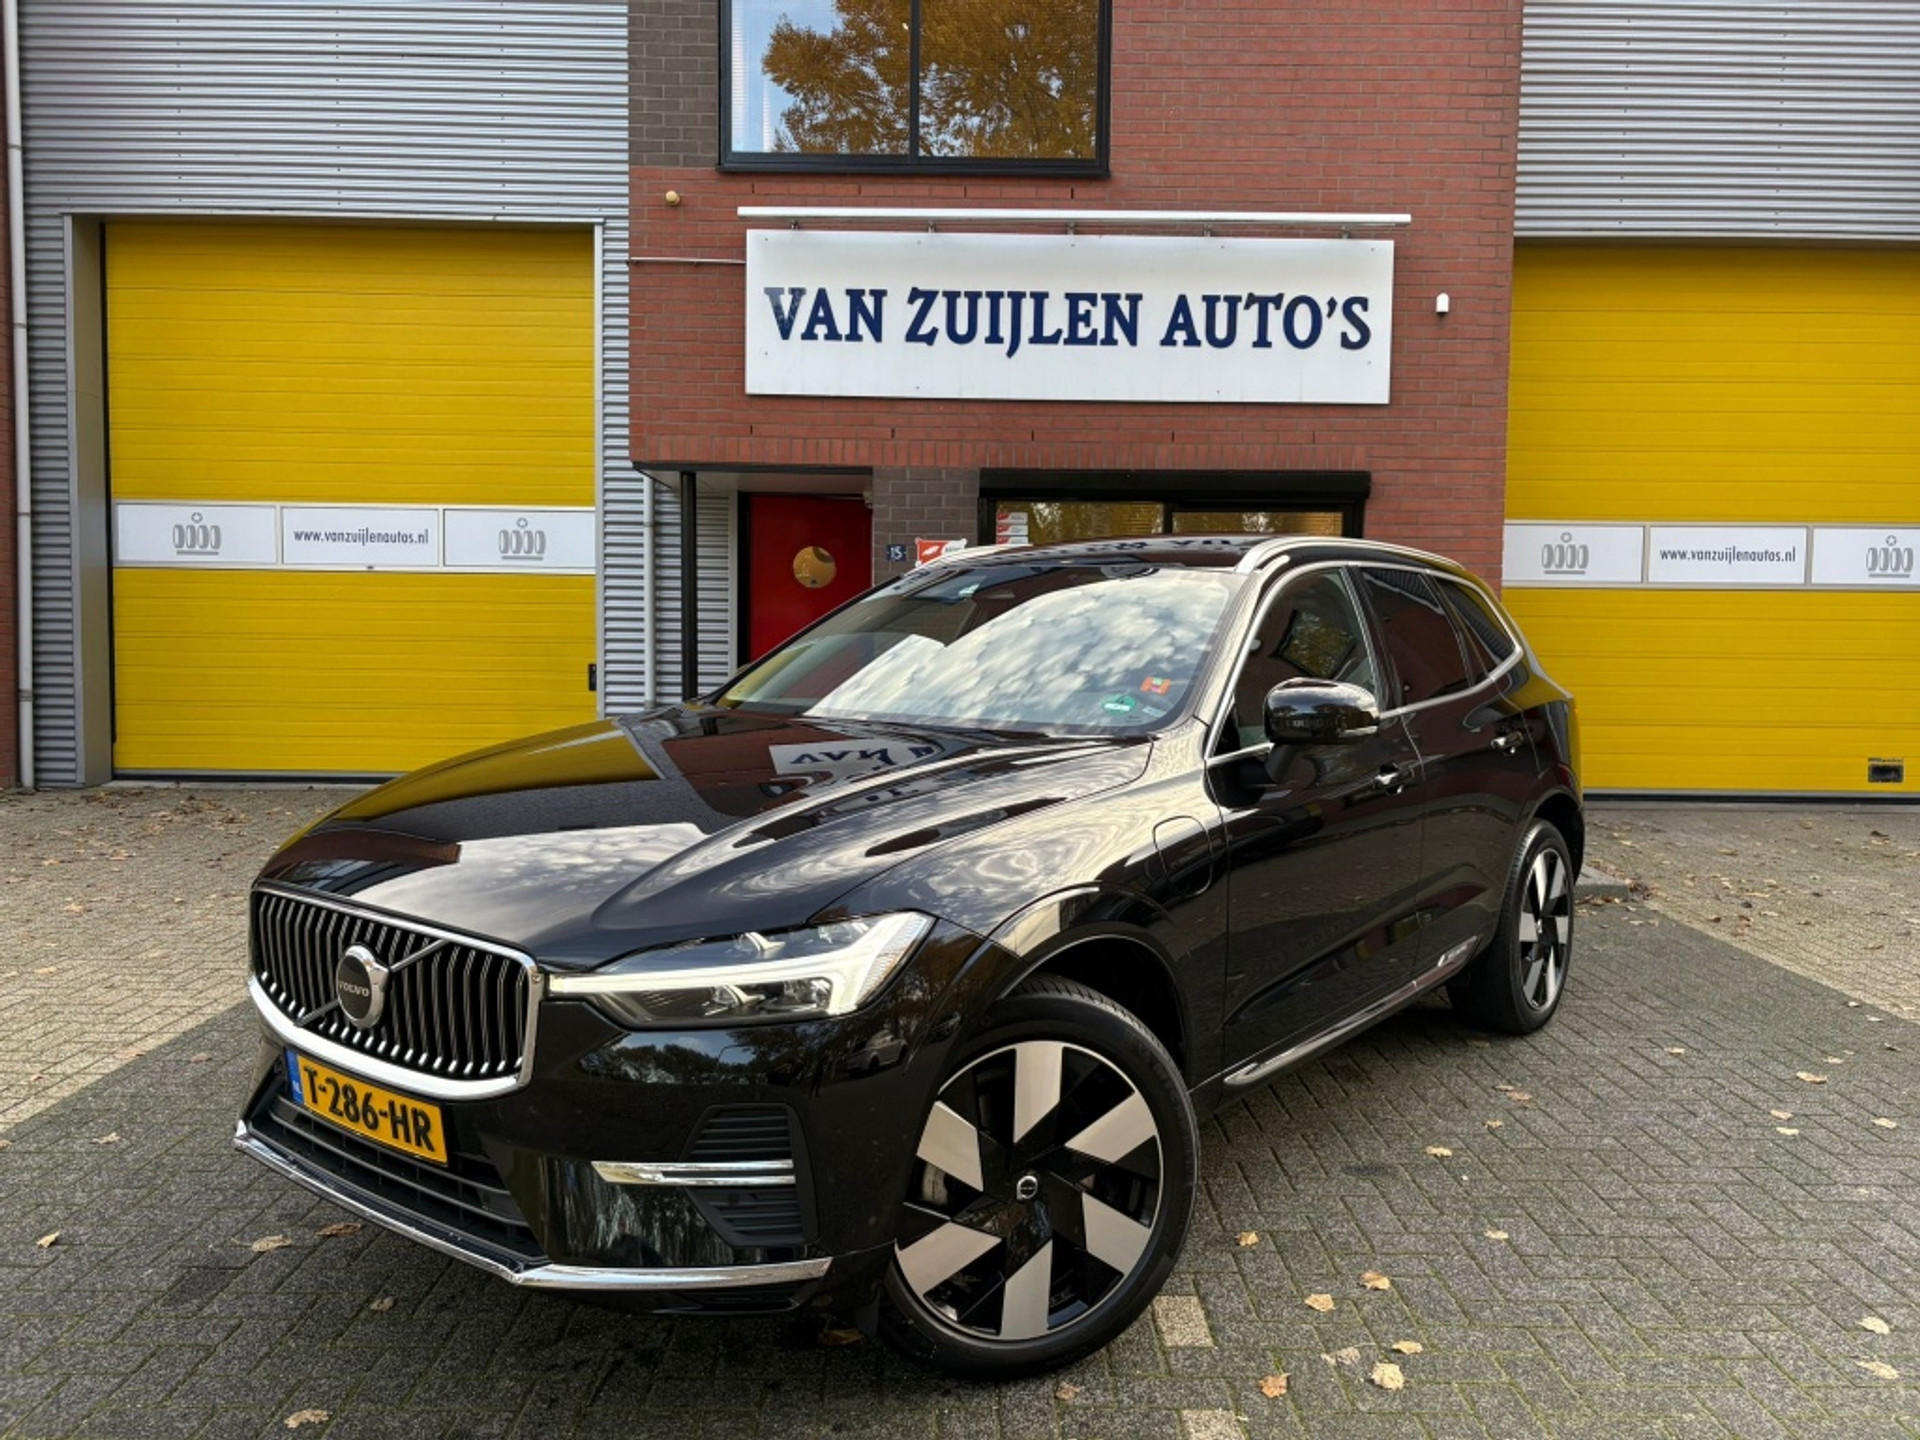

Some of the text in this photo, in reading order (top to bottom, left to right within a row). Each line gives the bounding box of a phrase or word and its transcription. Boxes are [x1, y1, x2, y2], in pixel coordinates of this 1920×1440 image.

[763, 286, 1372, 359] VAN ZUIJLEN AUTO'S
[293, 527, 429, 546] www.vanzuijlenautos.nl
[890, 545, 904, 561] 15
[1659, 546, 1796, 565] www.vanzuijlenautos.nl
[304, 1065, 435, 1152] T-286-HR
